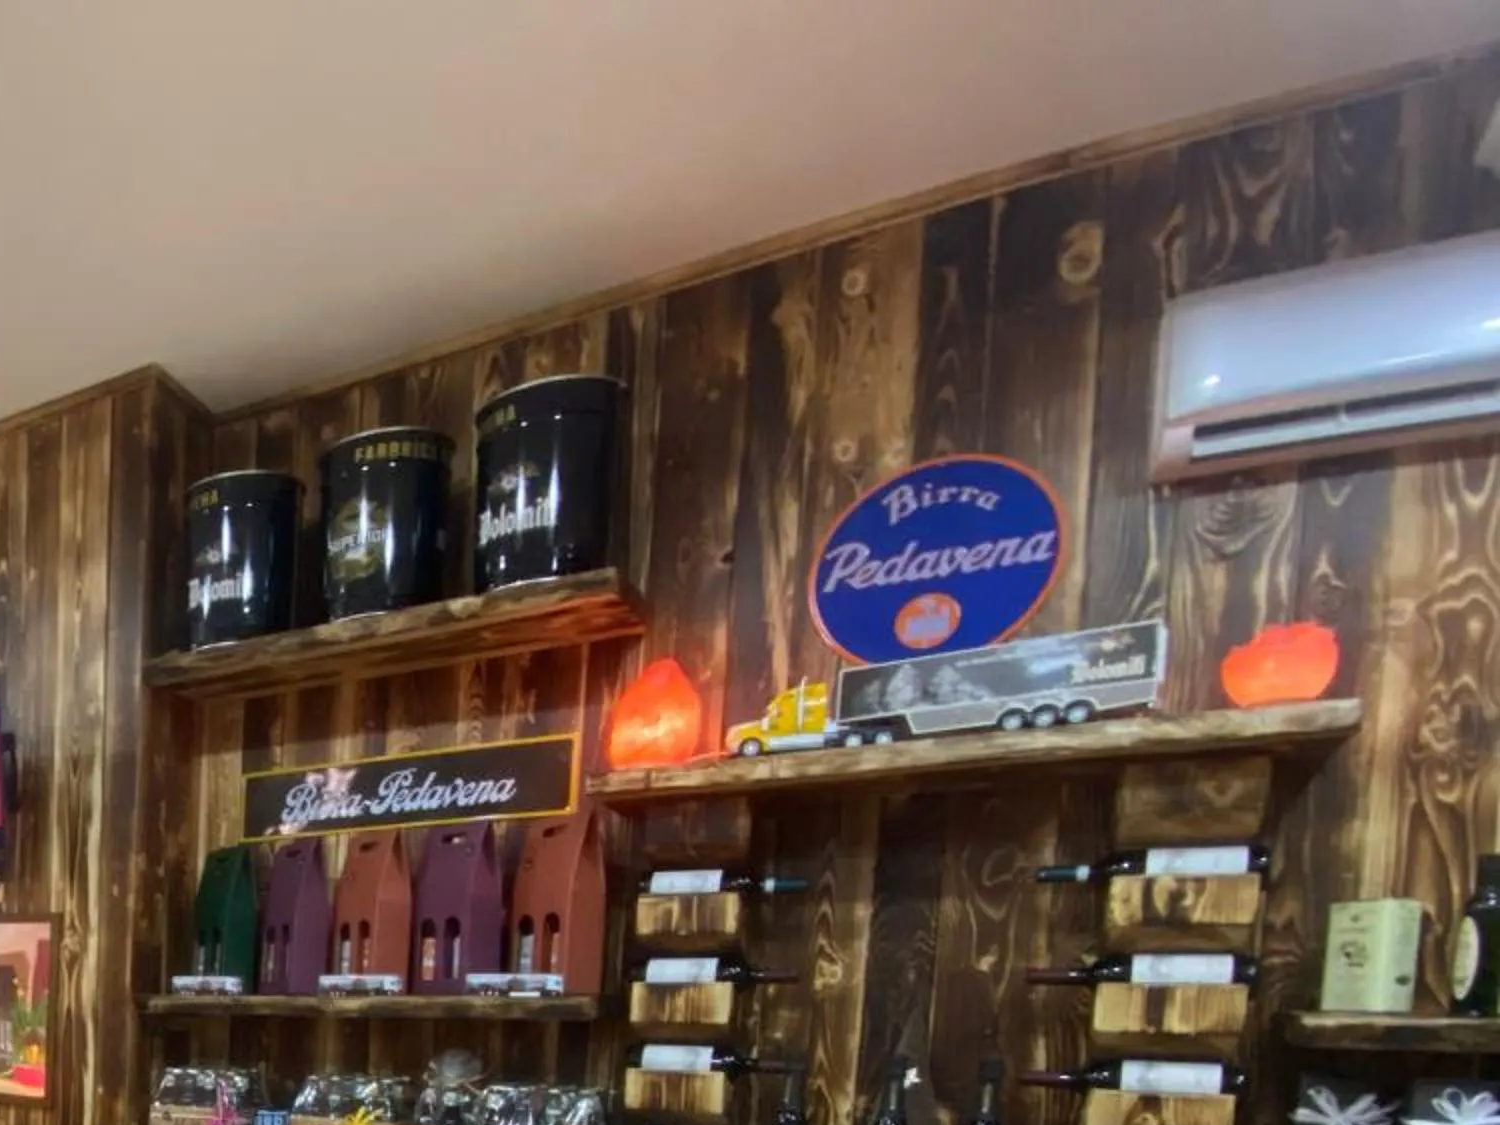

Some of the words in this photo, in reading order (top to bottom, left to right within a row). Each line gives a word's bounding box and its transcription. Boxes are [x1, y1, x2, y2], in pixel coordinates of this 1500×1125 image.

[882, 483, 1000, 526] Birra
[823, 531, 1056, 593] Pedavena
[370, 768, 518, 815] Pedavena
